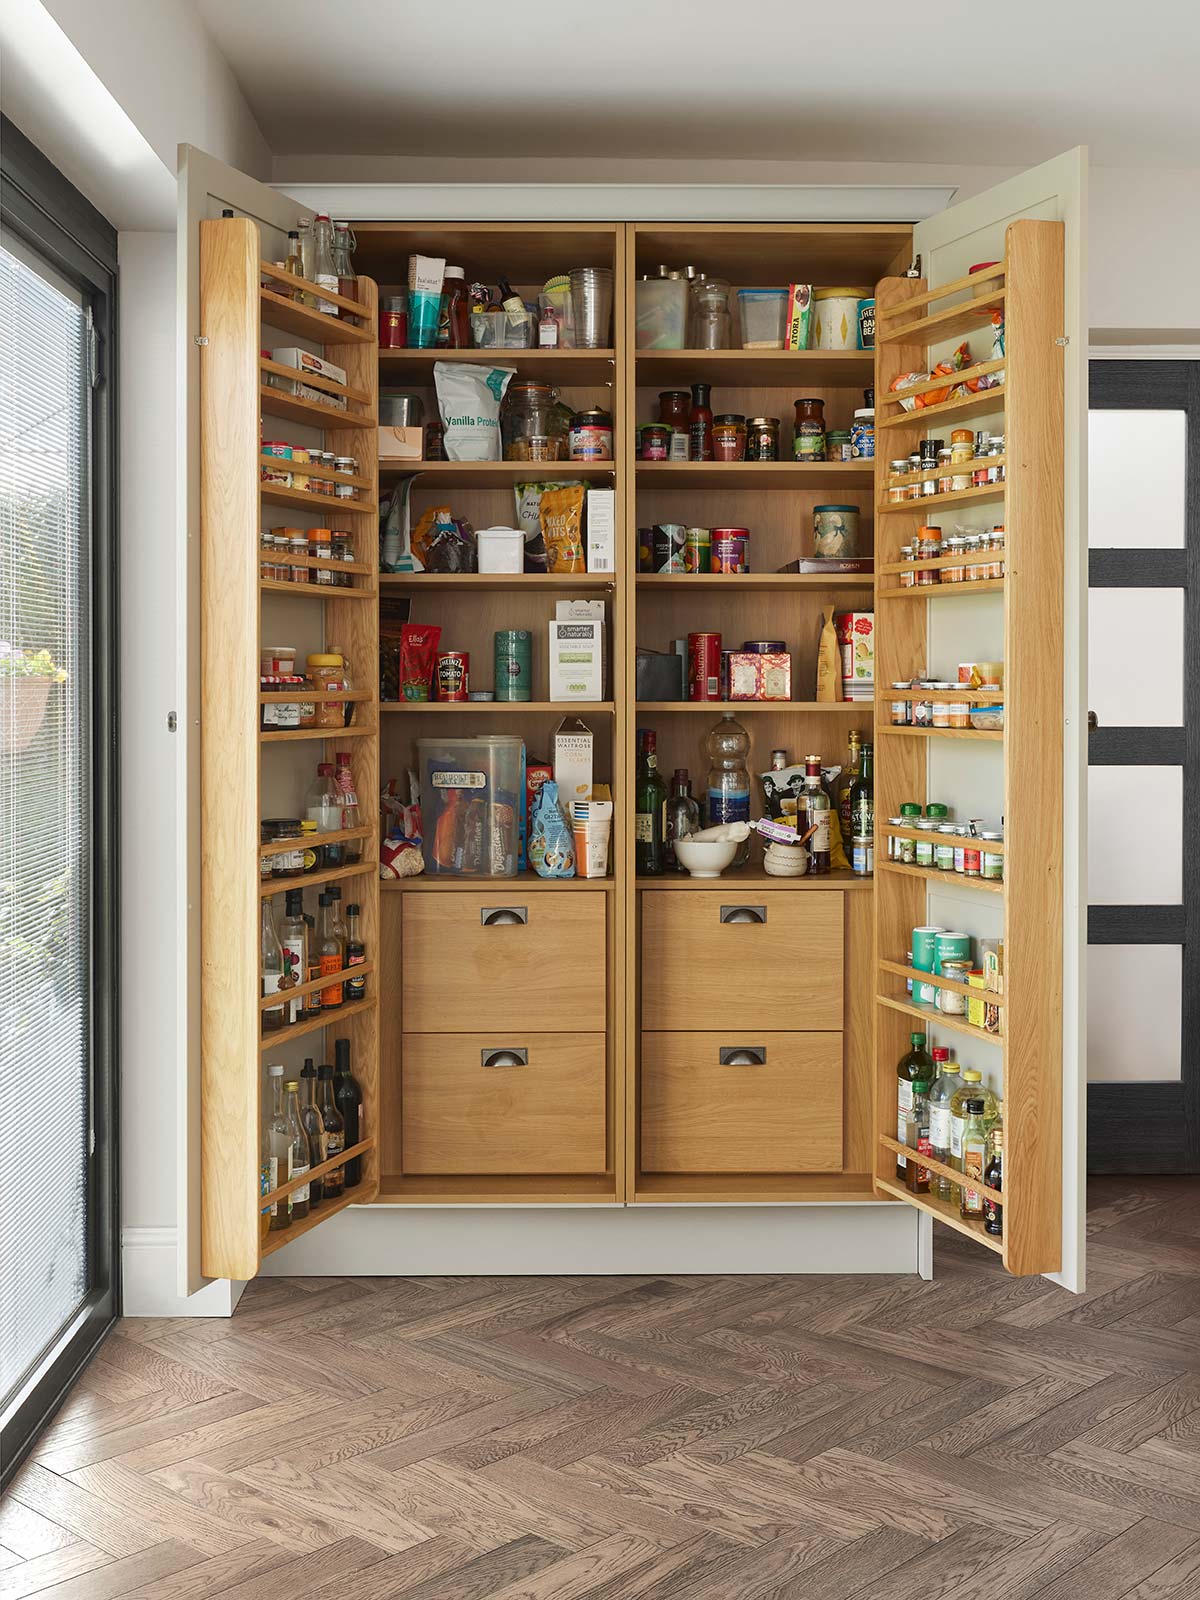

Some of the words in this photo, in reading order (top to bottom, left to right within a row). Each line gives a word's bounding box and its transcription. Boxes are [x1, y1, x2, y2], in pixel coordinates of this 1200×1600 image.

[791, 317, 800, 345] ATORA
[445, 416, 475, 427] Vanilla
[696, 636, 704, 681] Bournville
[440, 670, 462, 678] TOMATO
[494, 826, 505, 872] Digestives
